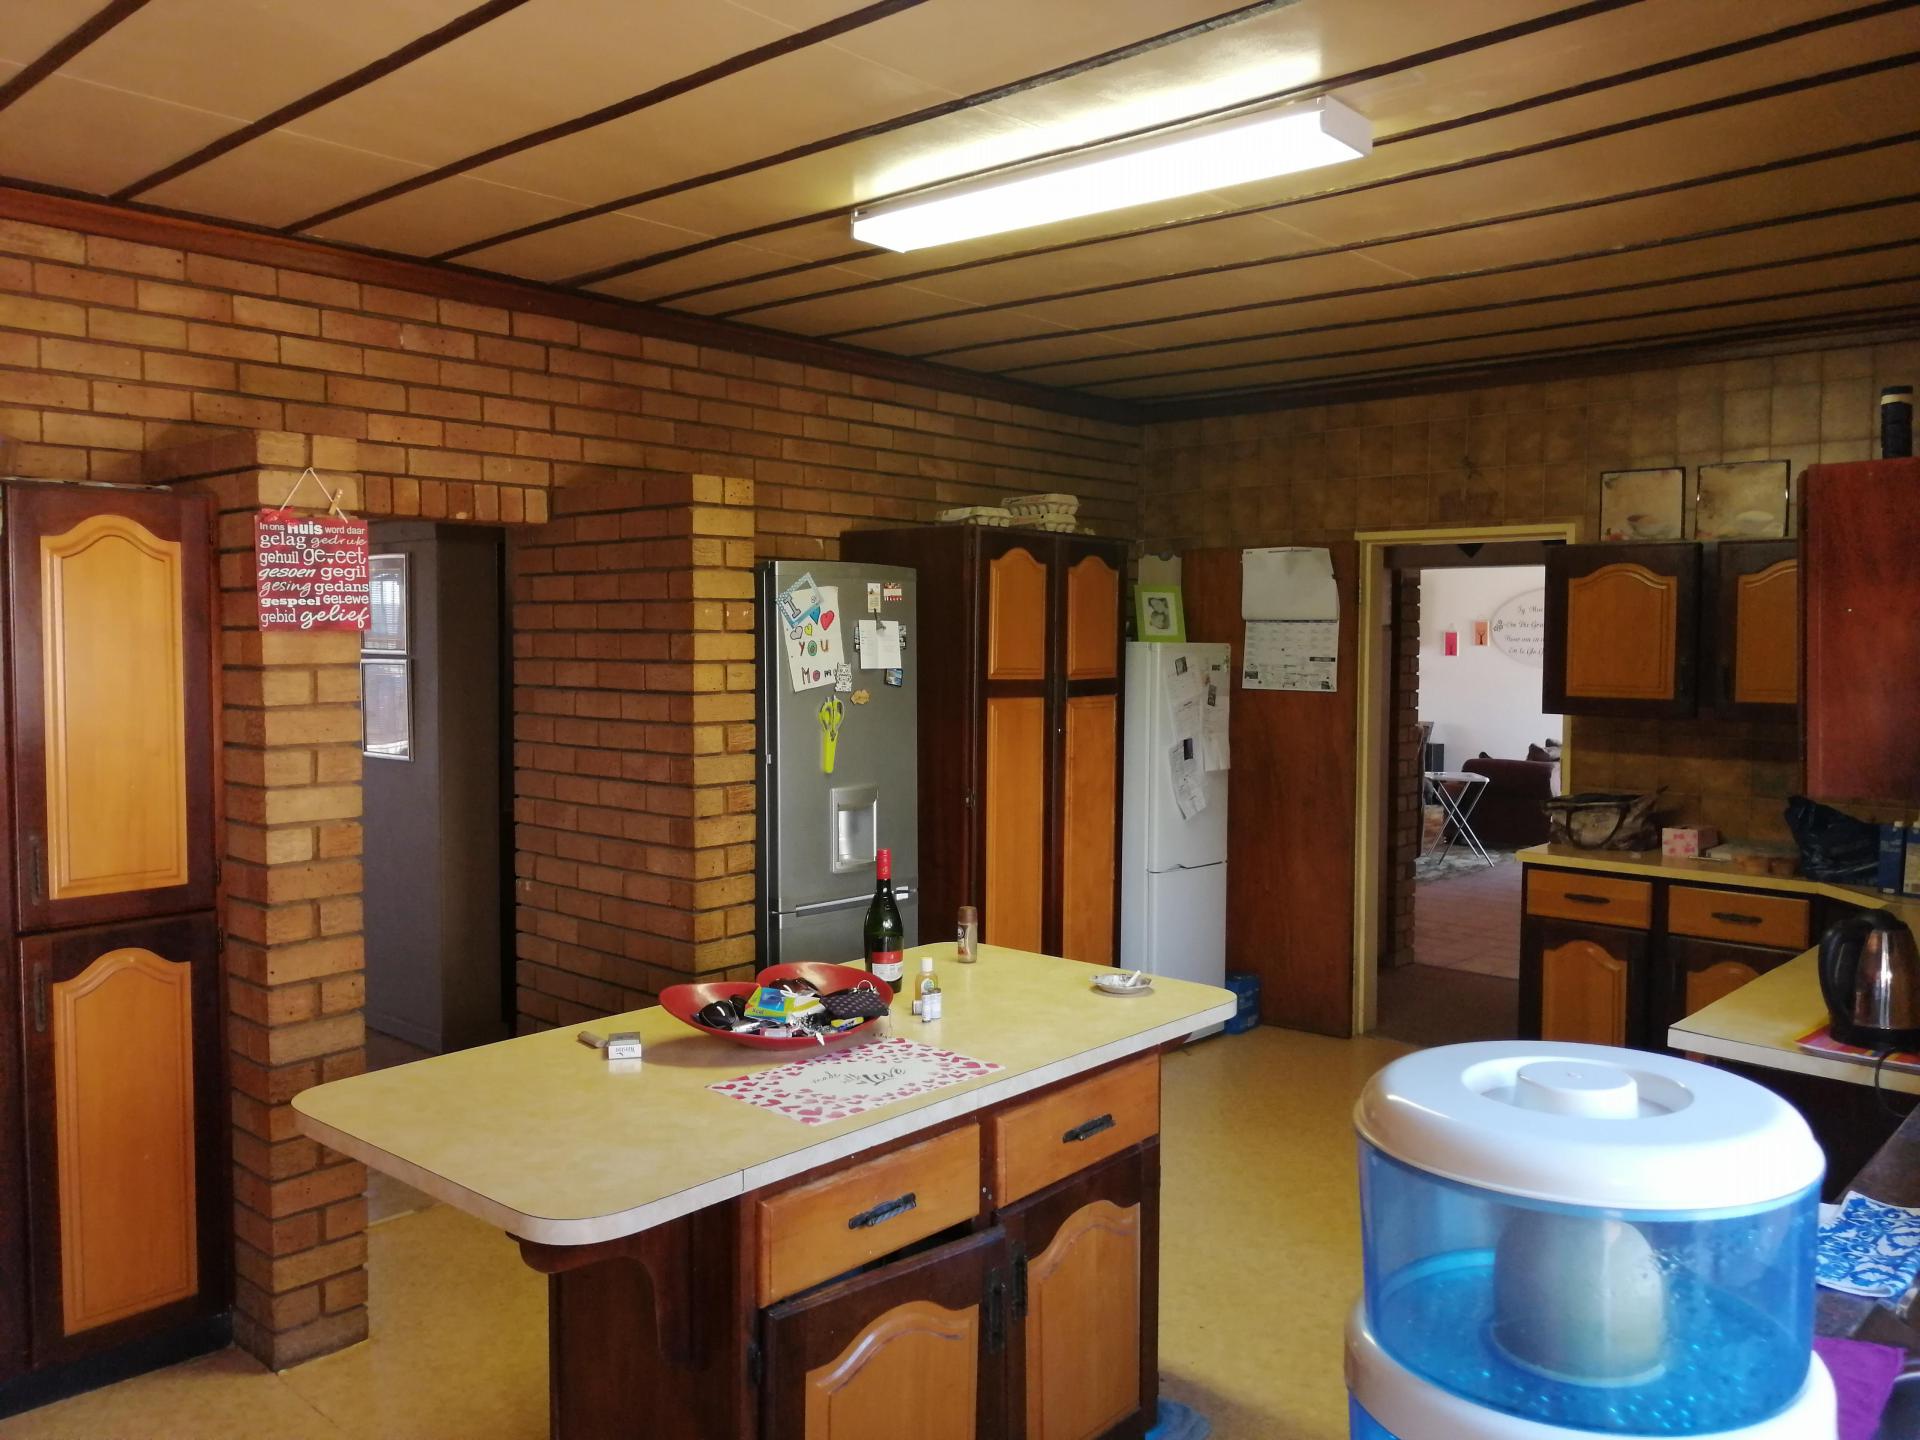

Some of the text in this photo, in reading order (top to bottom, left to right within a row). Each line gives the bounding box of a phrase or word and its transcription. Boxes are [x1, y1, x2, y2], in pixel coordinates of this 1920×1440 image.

[259, 522, 268, 530] In
[324, 526, 345, 534] word
[260, 532, 367, 549] gelag gedruk
[259, 547, 366, 566] gehuil ge-eet
[258, 566, 367, 581] gesoen gegil
[259, 580, 369, 597] gesing gedans
[261, 596, 321, 607] gespeel
[260, 605, 369, 629] gebid gelief
